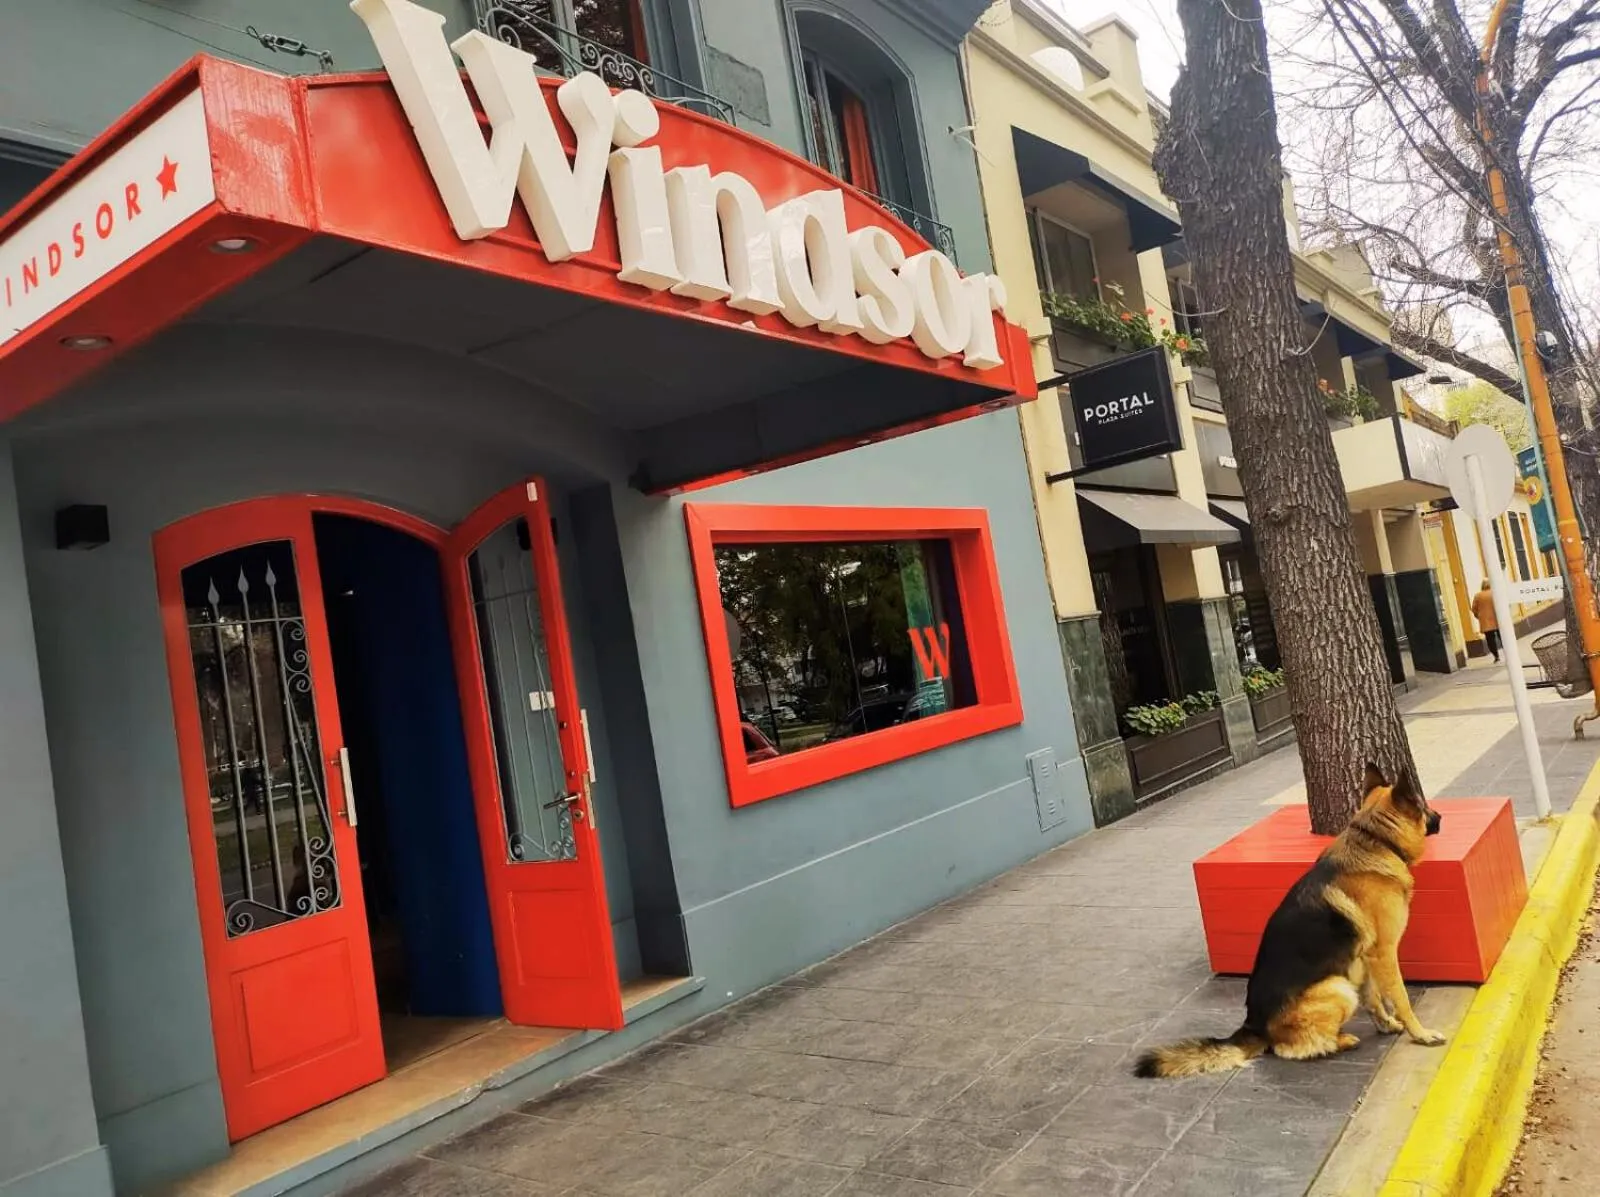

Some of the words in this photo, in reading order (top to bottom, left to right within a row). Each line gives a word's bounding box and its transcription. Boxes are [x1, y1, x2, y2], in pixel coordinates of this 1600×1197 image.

[350, 0, 1007, 371] Windsor
[1084, 392, 1154, 422] PORTAL
[1098, 416, 1118, 424] PLAZA
[1120, 409, 1143, 418] SUITES
[907, 622, 950, 680] W
